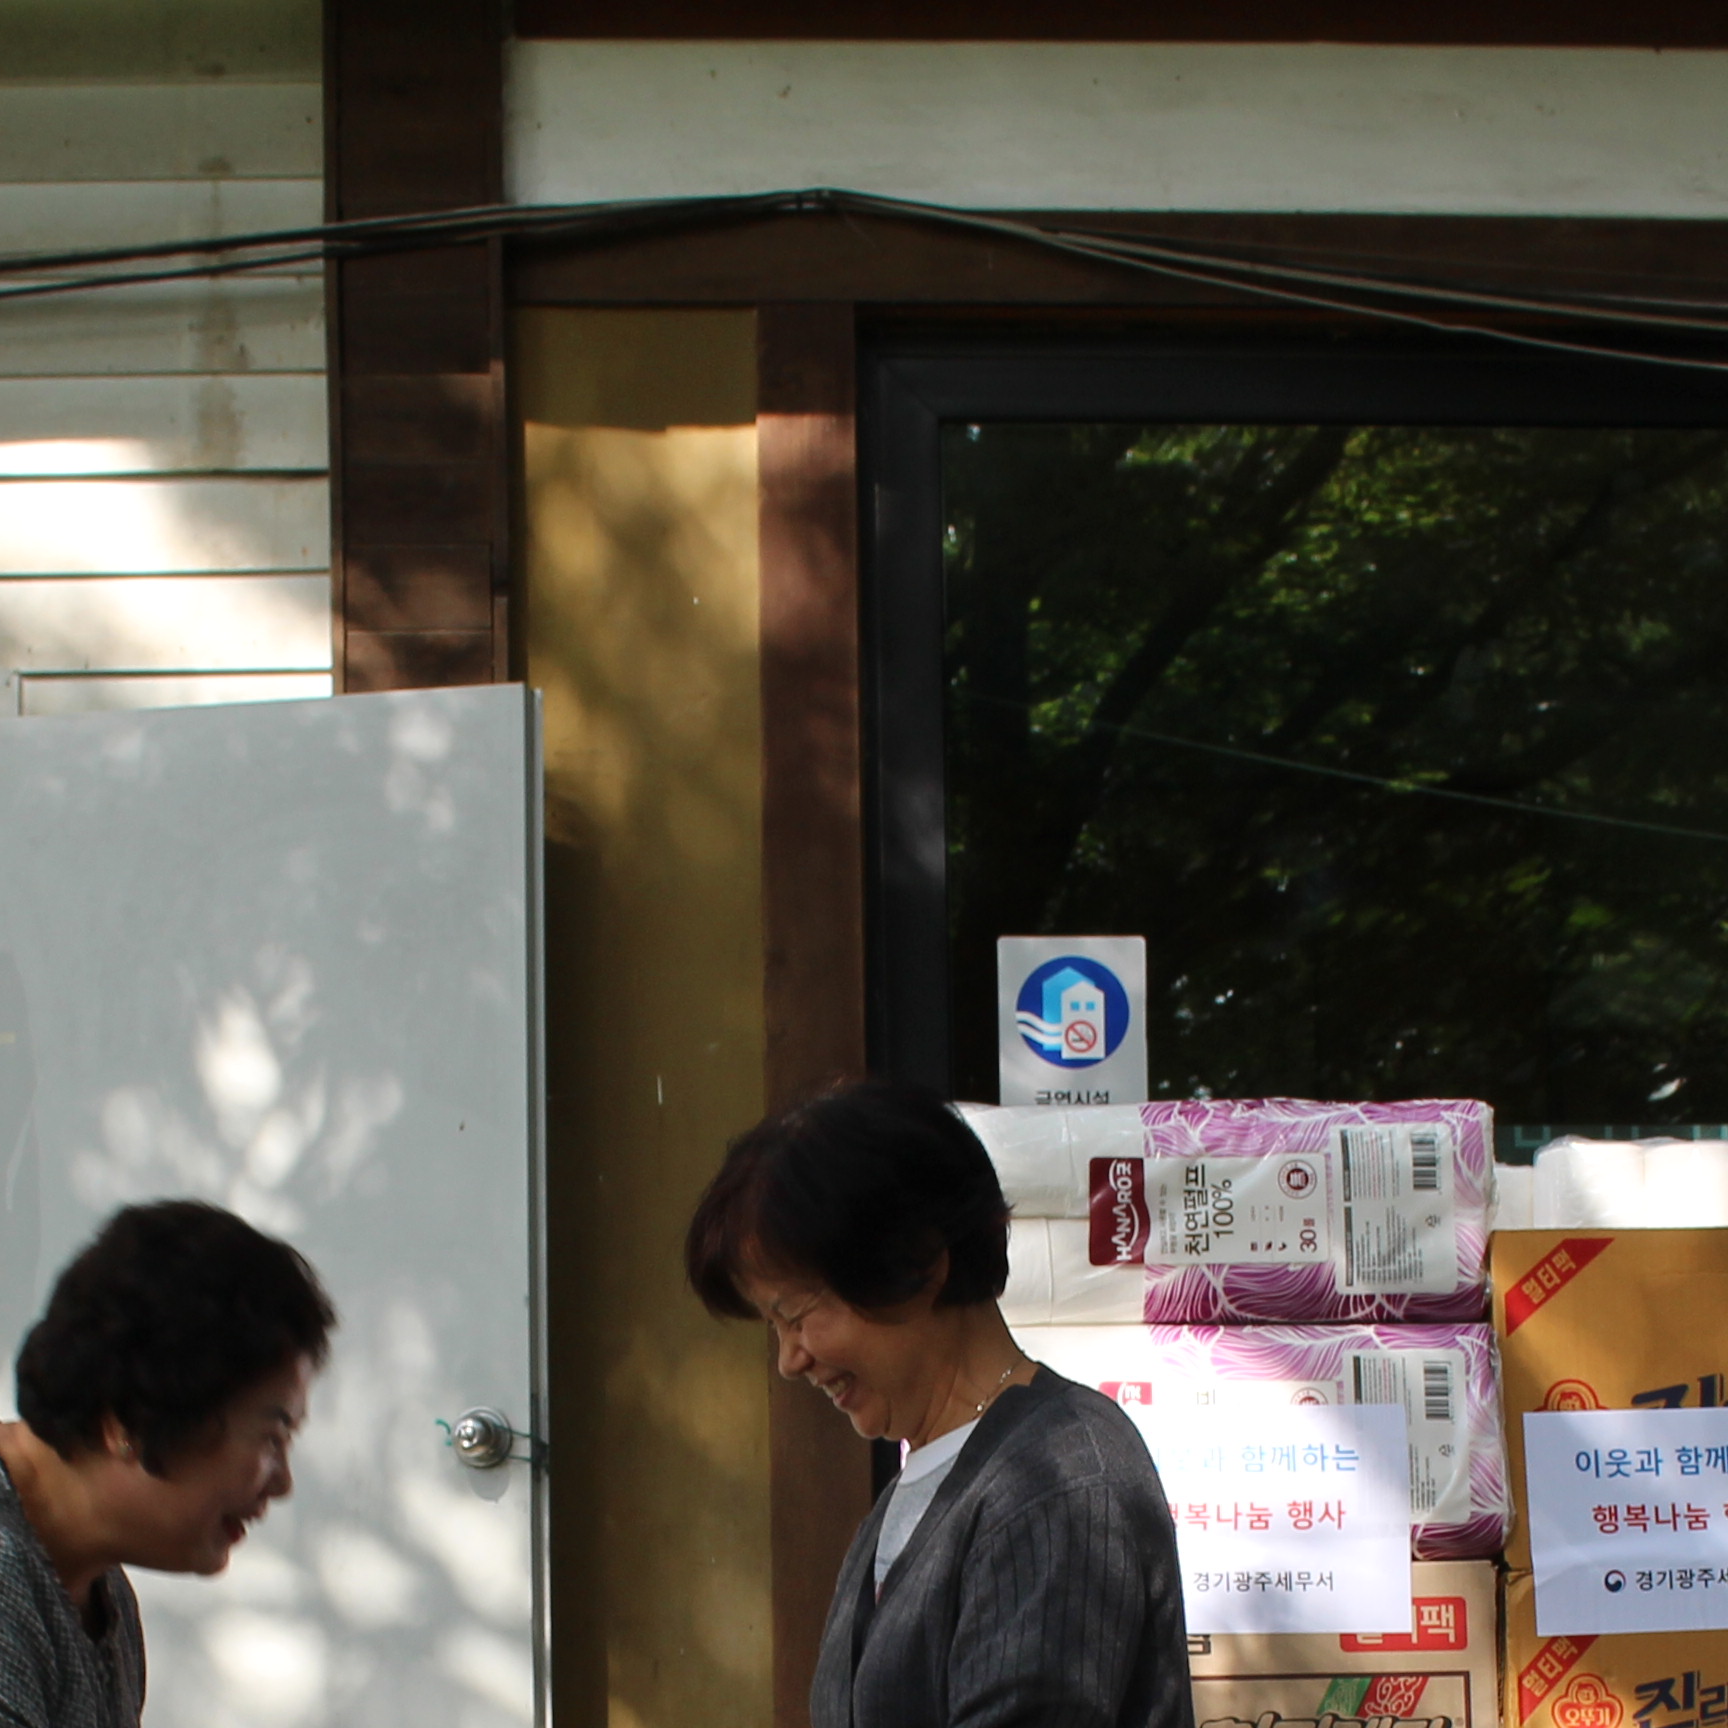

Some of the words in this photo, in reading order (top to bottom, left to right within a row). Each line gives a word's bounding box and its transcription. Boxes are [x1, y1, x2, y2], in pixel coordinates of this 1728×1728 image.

[1184, 1163, 1210, 1256] 천연펄프
[1212, 1178, 1235, 1239] 100%
[1241, 1443, 1361, 1473] 함께하는
[1575, 1446, 1664, 1479] 이웃과
[1287, 1500, 1347, 1531] 행사
[1591, 1500, 1711, 1535] 행복나눔
[1193, 1571, 1335, 1593] 경기광주세무서
[1565, 1709, 1611, 1727] 오뚜기
